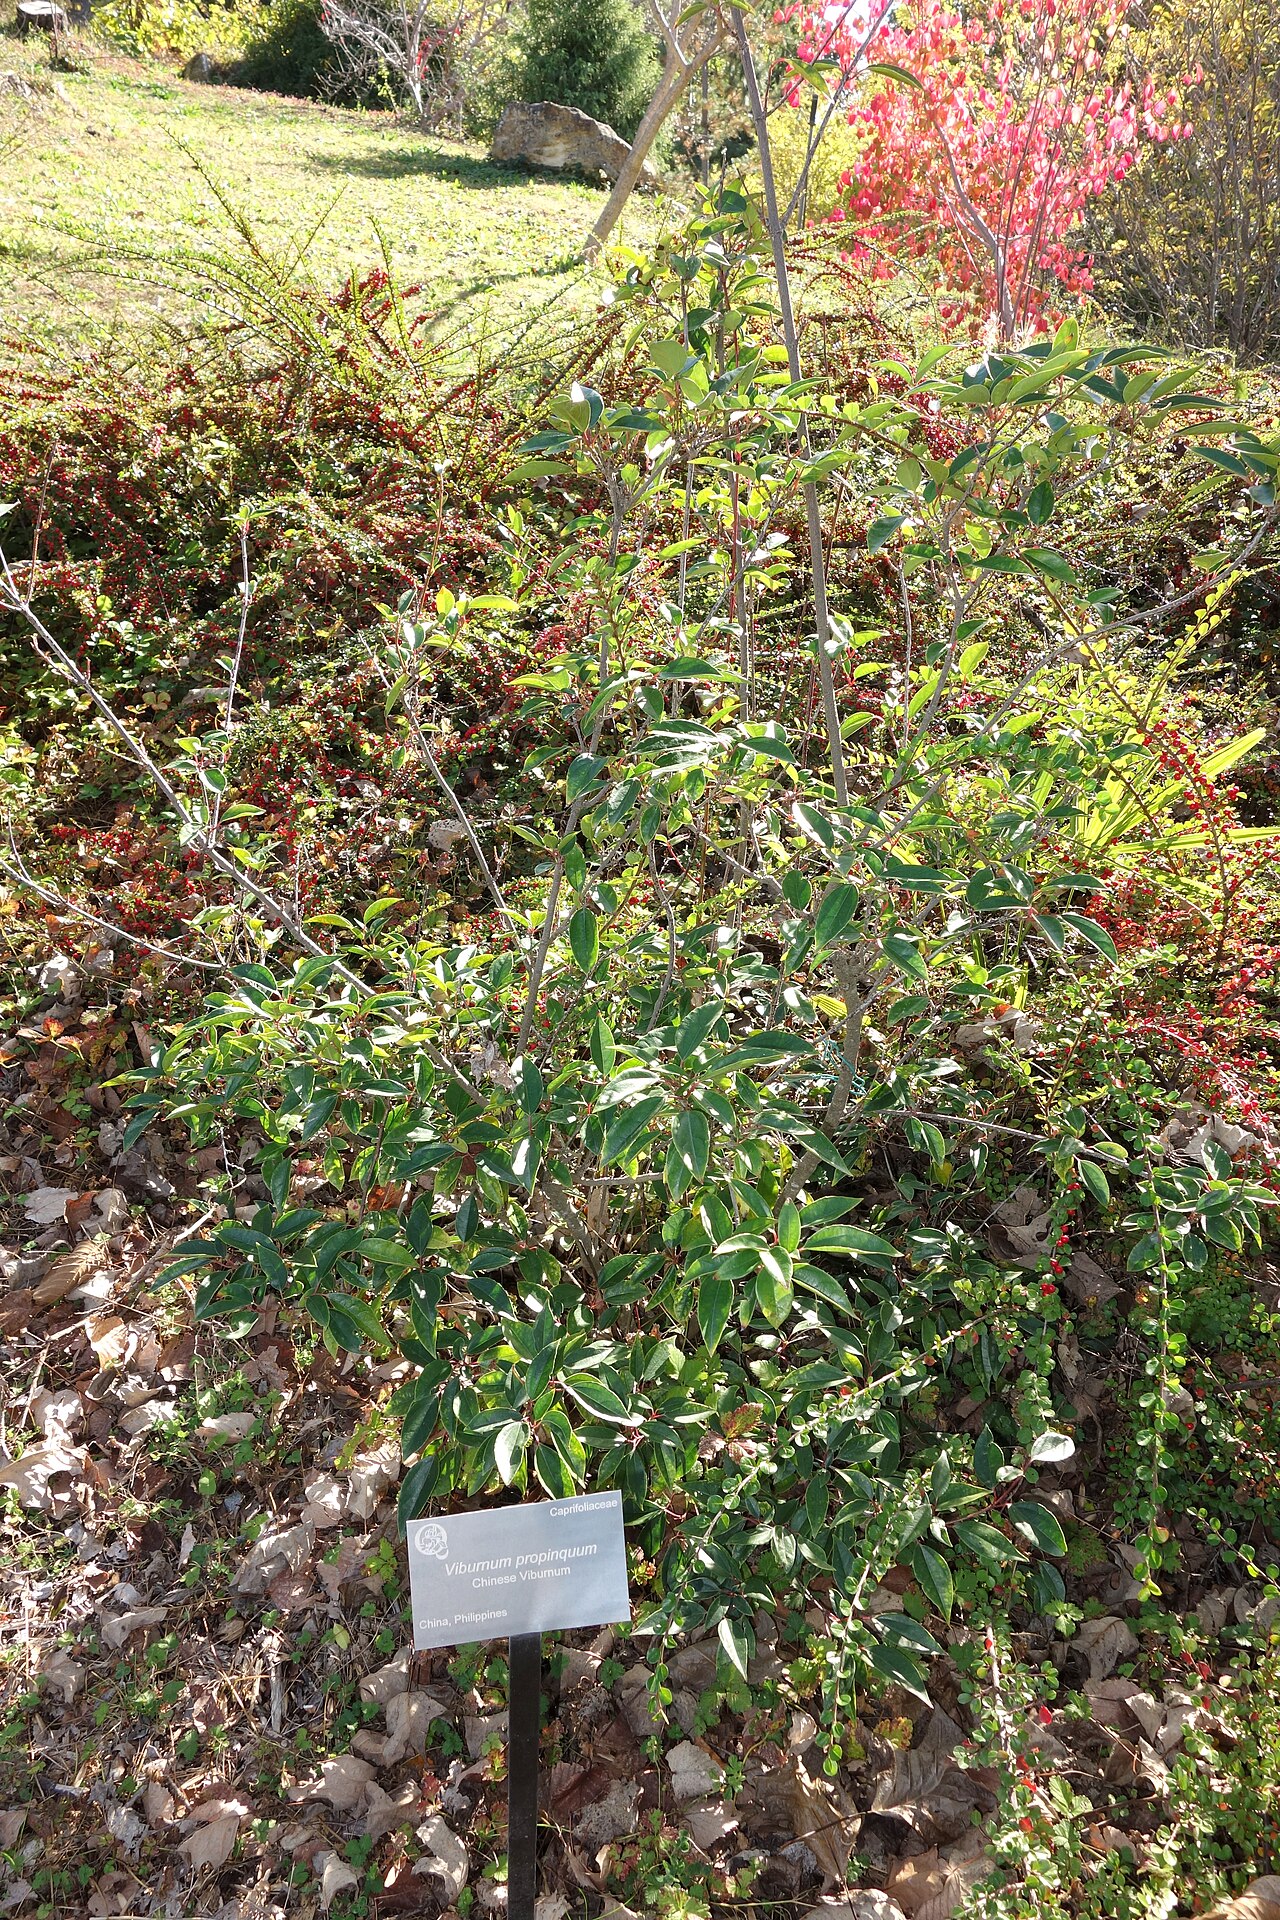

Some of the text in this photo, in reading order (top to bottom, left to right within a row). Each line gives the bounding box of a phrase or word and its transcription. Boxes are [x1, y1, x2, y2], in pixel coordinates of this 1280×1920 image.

[549, 1499, 618, 1517] Caprifoliaceae
[445, 1543, 598, 1576] Viburnum propinquum
[472, 1565, 571, 1589] Chinese Viburnum
[419, 1607, 508, 1630] China, Philippines
